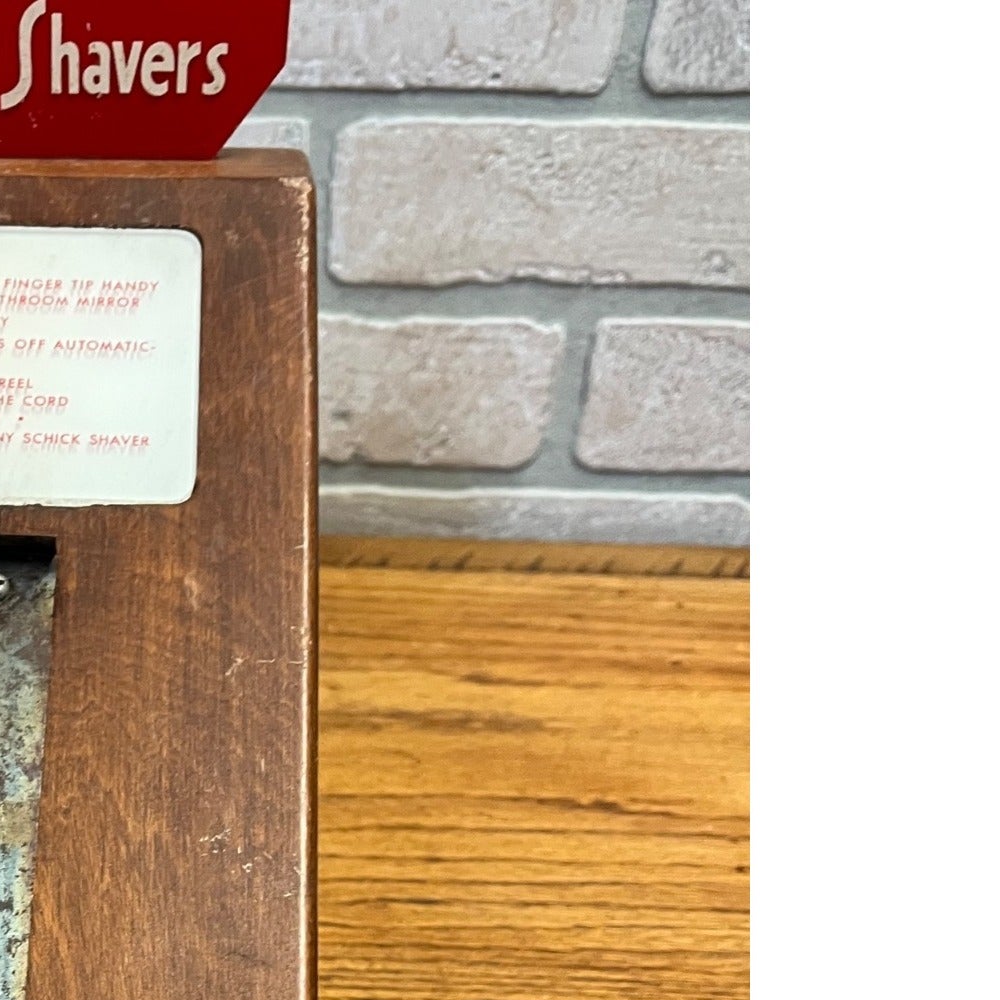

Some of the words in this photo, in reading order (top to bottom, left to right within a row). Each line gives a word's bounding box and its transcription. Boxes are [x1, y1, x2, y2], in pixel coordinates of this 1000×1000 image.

[0, 0, 229, 110] Shavers
[3, 279, 63, 290] FINGER
[72, 279, 94, 290] TIP
[101, 280, 160, 292] HANDY
[77, 297, 141, 308] MIRROR
[14, 338, 46, 350] OFF
[53, 339, 156, 352] AUTOMATIC-
[22, 395, 69, 407] CORD
[22, 433, 81, 445] SCHICK
[89, 434, 150, 446] SHAVER
